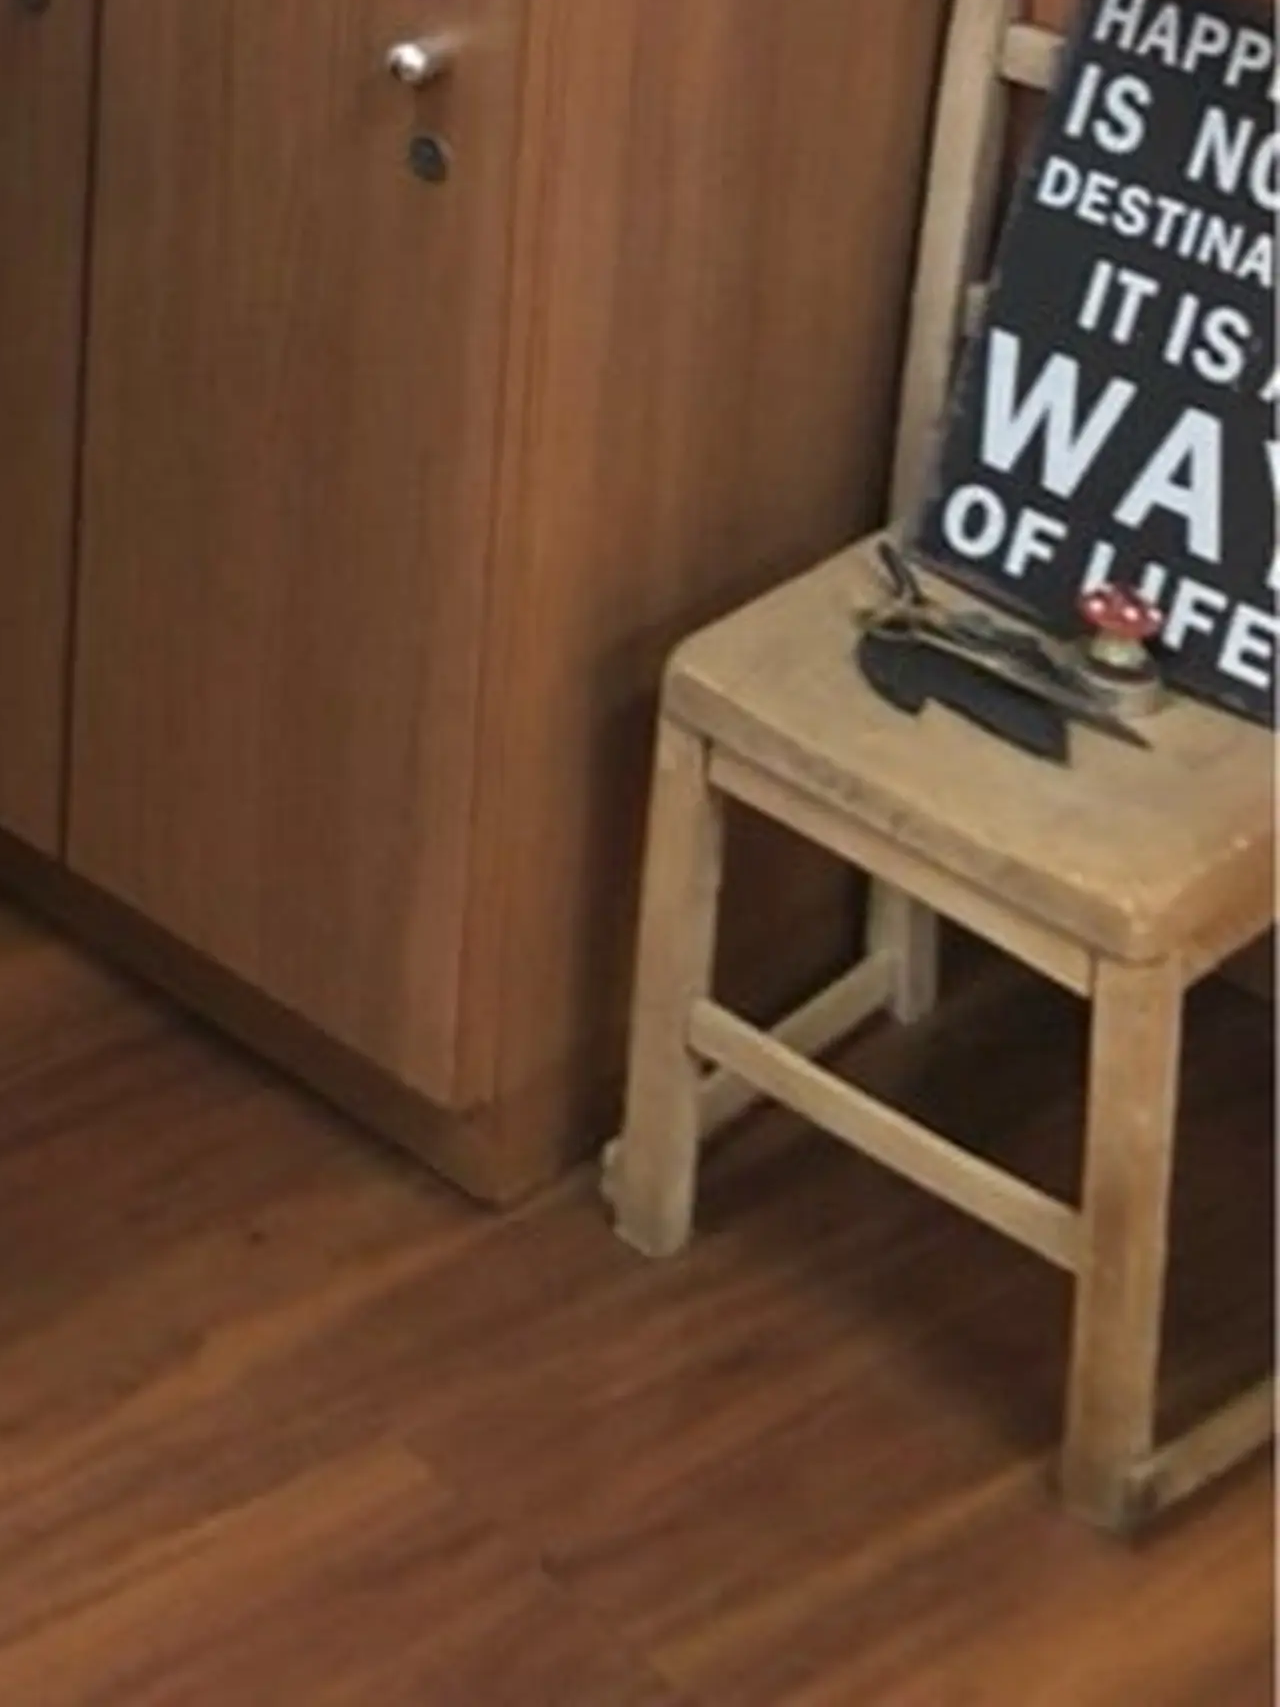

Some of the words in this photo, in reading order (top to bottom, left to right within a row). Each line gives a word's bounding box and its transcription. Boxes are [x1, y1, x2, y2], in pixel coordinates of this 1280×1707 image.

[1065, 62, 1152, 154] IS
[1077, 259, 1159, 344] IT
[1163, 294, 1251, 383] IS
[980, 327, 1276, 588] WA
[943, 484, 1068, 579] OF
